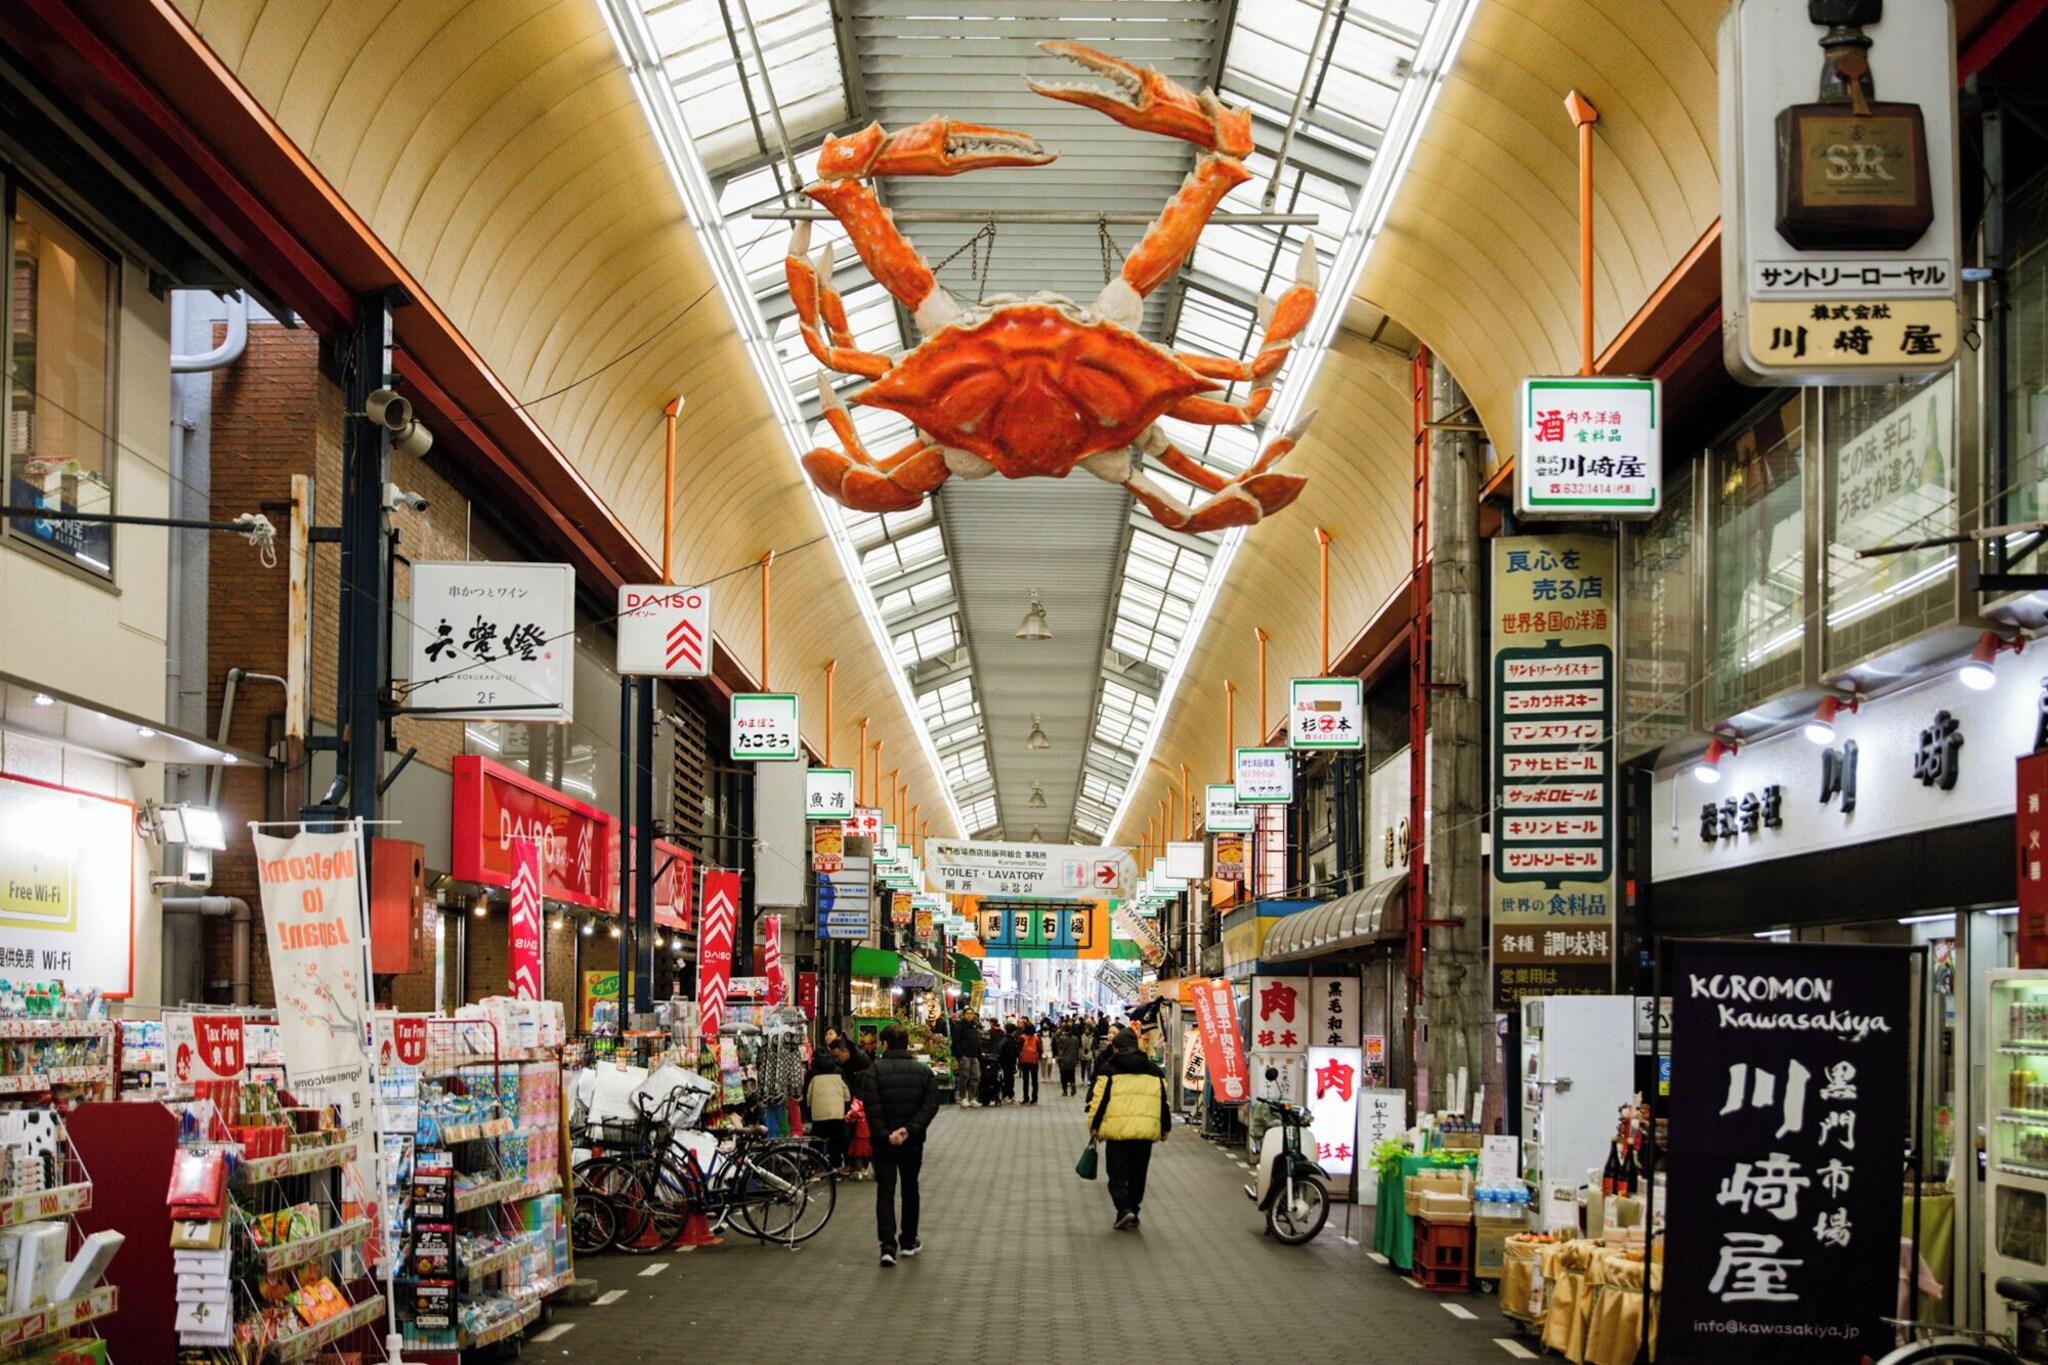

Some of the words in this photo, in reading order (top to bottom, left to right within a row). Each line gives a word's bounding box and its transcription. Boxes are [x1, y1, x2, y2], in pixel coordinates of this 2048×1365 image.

[1761, 266, 1946, 287] サントリーローヤル
[1810, 304, 1892, 321] 株式会社
[1536, 410, 1565, 443] 酒
[1566, 411, 1623, 425] 内外洋酒
[1574, 429, 1623, 443] 食料品
[1506, 548, 1580, 573] 良心を
[449, 586, 529, 598] 串かつとワイン
[1532, 576, 1603, 601] 売る店
[627, 593, 702, 609] DAISO
[1502, 609, 1607, 634] 世界各国の洋酒
[1508, 664, 1600, 677] サントリーウイスキー
[477, 691, 496, 704] 2F
[738, 718, 775, 729] かまぼこ
[1508, 724, 1598, 740] マンズワイン
[738, 733, 790, 748] たこそう
[1508, 756, 1598, 771] アサヒビール
[810, 791, 846, 808] 魚清
[1508, 788, 1598, 803] サッポロビール
[1508, 820, 1598, 835] キリンビール
[1508, 853, 1598, 867] サントリービール
[941, 867, 979, 878] TOILET
[988, 870, 1044, 881] LAVATORY
[9, 880, 33, 900] Free
[35, 884, 61, 904] Wi-Fi
[1501, 894, 1606, 917] 世界の食料品
[1501, 934, 1535, 953] 各種
[1543, 931, 1608, 957] 調味料
[42, 951, 71, 971] Wi-Fi
[704, 950, 731, 961] DAISO
[1260, 981, 1298, 1024] 肉
[1327, 981, 1344, 1046] 黒毛和牛
[1718, 1003, 1893, 1042] Kawasakiya
[1257, 1030, 1298, 1048] 杉本
[1315, 1058, 1355, 1103] 肉
[1812, 1060, 1858, 1249] 黒門市場
[1693, 1319, 1861, 1339] info@kawasakiya.jp
